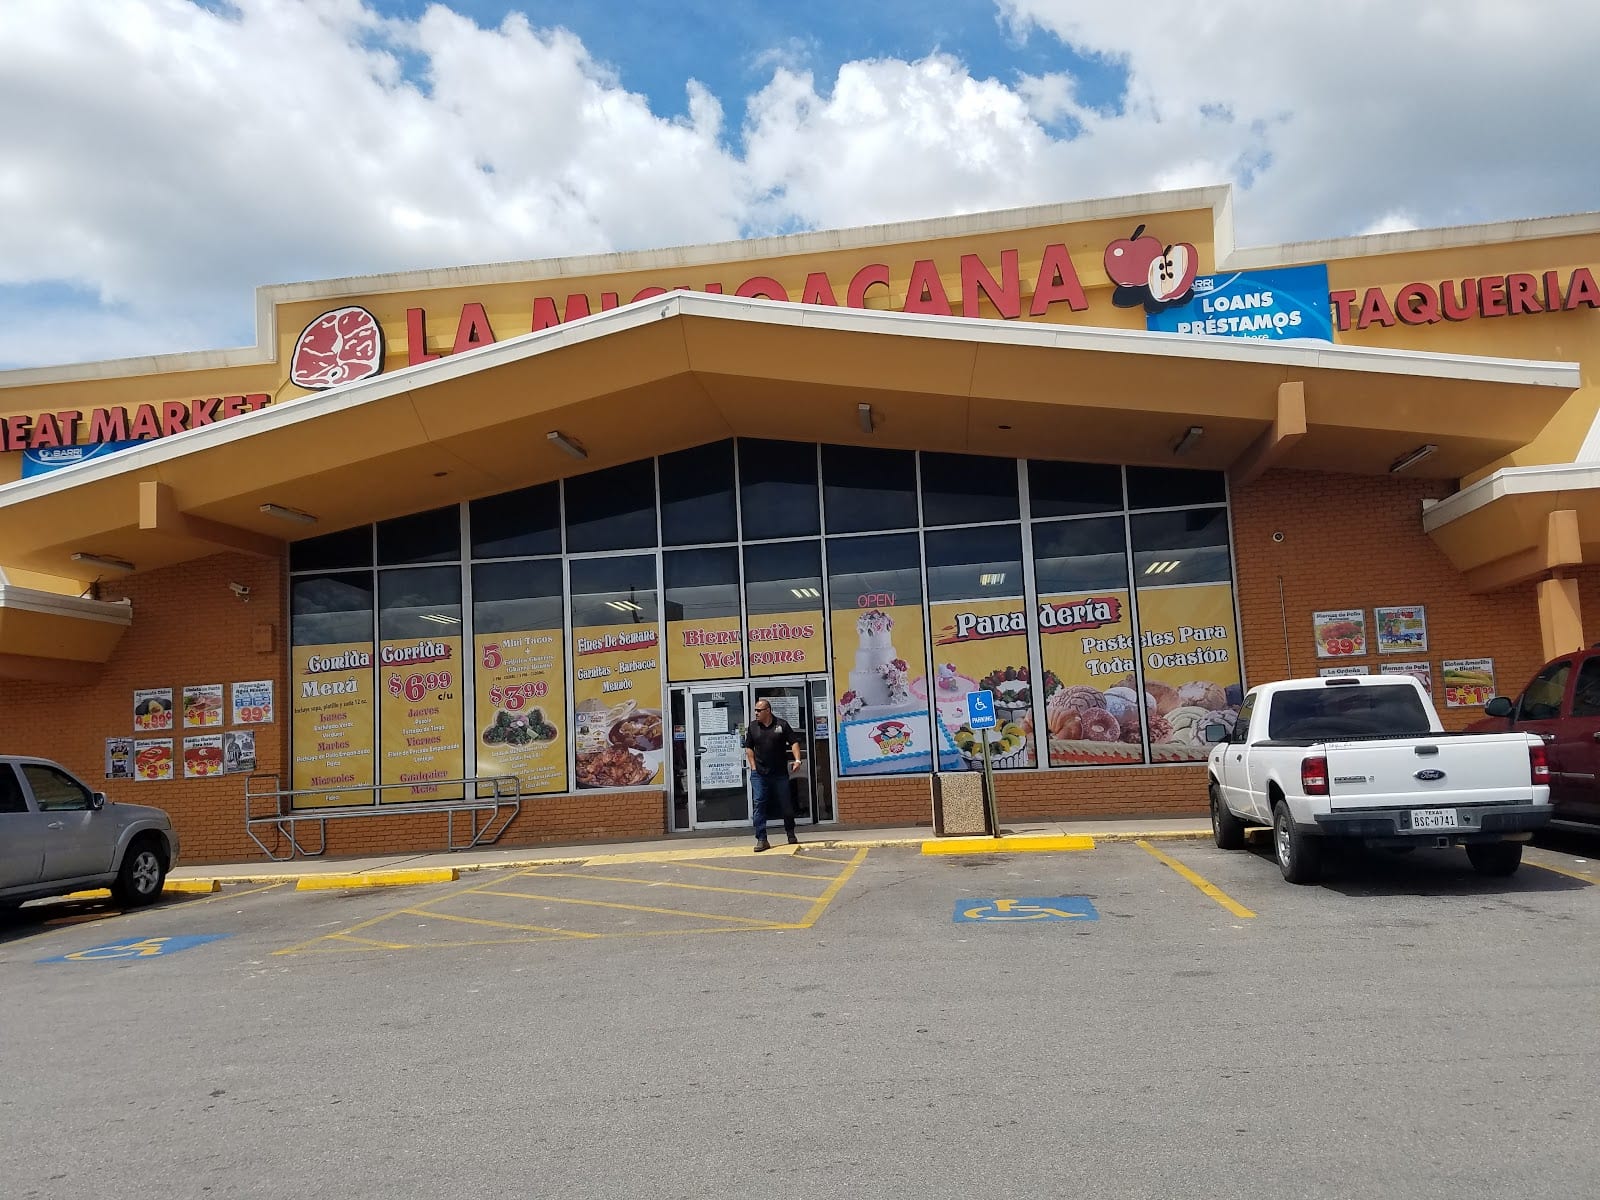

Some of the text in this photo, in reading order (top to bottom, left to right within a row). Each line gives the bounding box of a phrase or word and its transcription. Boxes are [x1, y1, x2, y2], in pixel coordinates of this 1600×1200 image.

[1190, 278, 1214, 288] ARRI
[407, 243, 1089, 366] LA MACANA
[1202, 292, 1274, 313] LOANS
[1330, 268, 1600, 331] TAQUERIA
[1177, 311, 1302, 335] PRÉSTAMOS
[0, 410, 82, 452] EAT
[857, 592, 896, 608] OPEN
[956, 598, 1112, 638] Panadería
[502, 636, 553, 648] Mini Tacos
[577, 630, 657, 654] Fines De Semana
[683, 623, 815, 647] Bienvenidos
[1178, 624, 1228, 643] Para
[308, 640, 446, 673] Comida Corrida
[482, 643, 503, 670] 5
[700, 649, 806, 669] Welcome
[1086, 646, 1229, 677] Toda Ocasión
[577, 658, 657, 681] Carnitas Barbacoa
[301, 676, 358, 699] Menú
[437, 692, 453, 701] c/u
[602, 679, 634, 694] Menudo
[1446, 688, 1457, 704] 5
[970, 715, 994, 725] PARKING
[1420, 768, 1441, 780] Ford
